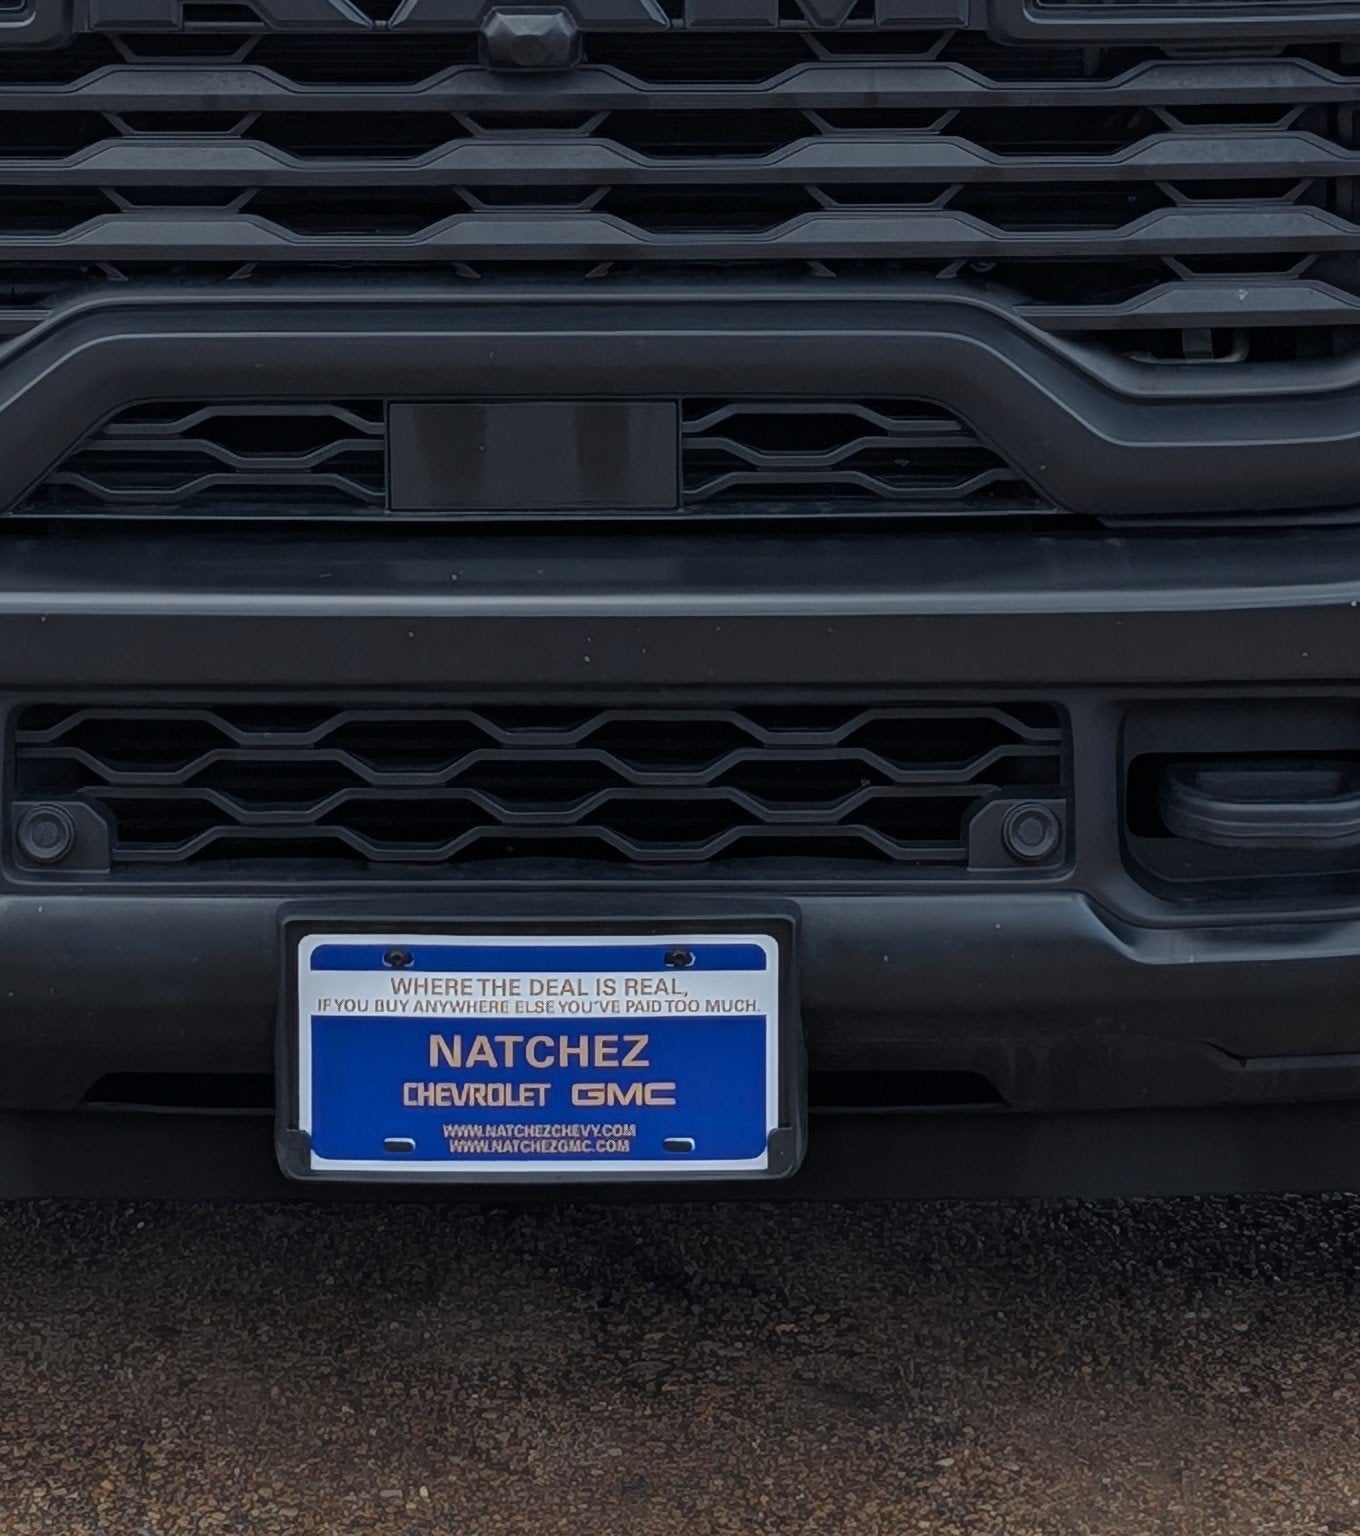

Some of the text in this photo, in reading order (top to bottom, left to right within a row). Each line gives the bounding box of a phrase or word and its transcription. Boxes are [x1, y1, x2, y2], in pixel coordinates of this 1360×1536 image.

[390, 977, 688, 997] WHERE THE DEAL IS REAL,
[317, 998, 761, 1014] IF YOU BUY ANYWHERE ELSE YOU'VE PAID TOO MUCH.
[429, 1034, 650, 1068] NATCHEZ
[403, 1082, 676, 1106] CHEVROLET GMC
[442, 1124, 636, 1138] WWW.NATCHEZCHEVY.COM
[449, 1139, 630, 1153] WWW.NATCHEZGMC.COM
